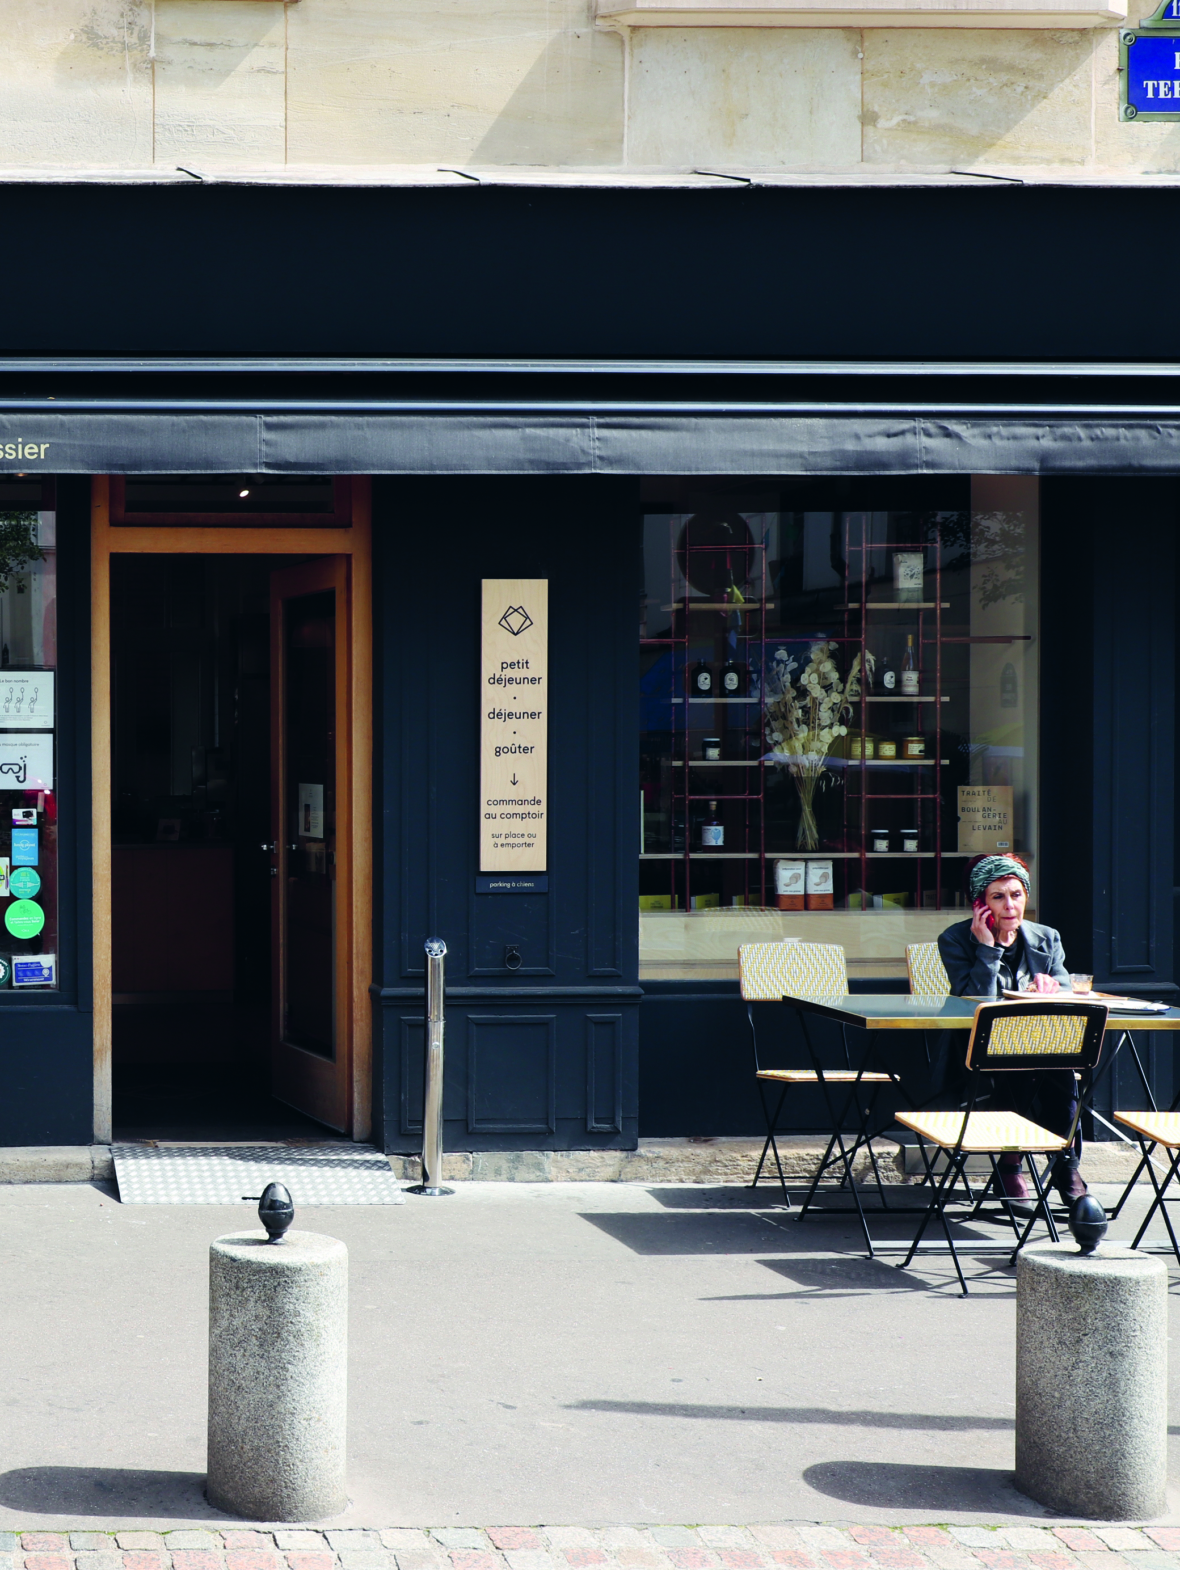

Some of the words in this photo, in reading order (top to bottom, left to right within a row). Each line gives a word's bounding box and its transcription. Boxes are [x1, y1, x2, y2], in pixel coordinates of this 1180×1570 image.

[500, 659, 530, 672] petit
[487, 673, 542, 688] déjeuner
[487, 708, 542, 722] déjeuner
[494, 743, 535, 757] goûter
[486, 796, 542, 806] commande
[499, 810, 544, 821] comptoir
[504, 831, 525, 840] place
[500, 842, 535, 850] emporter
